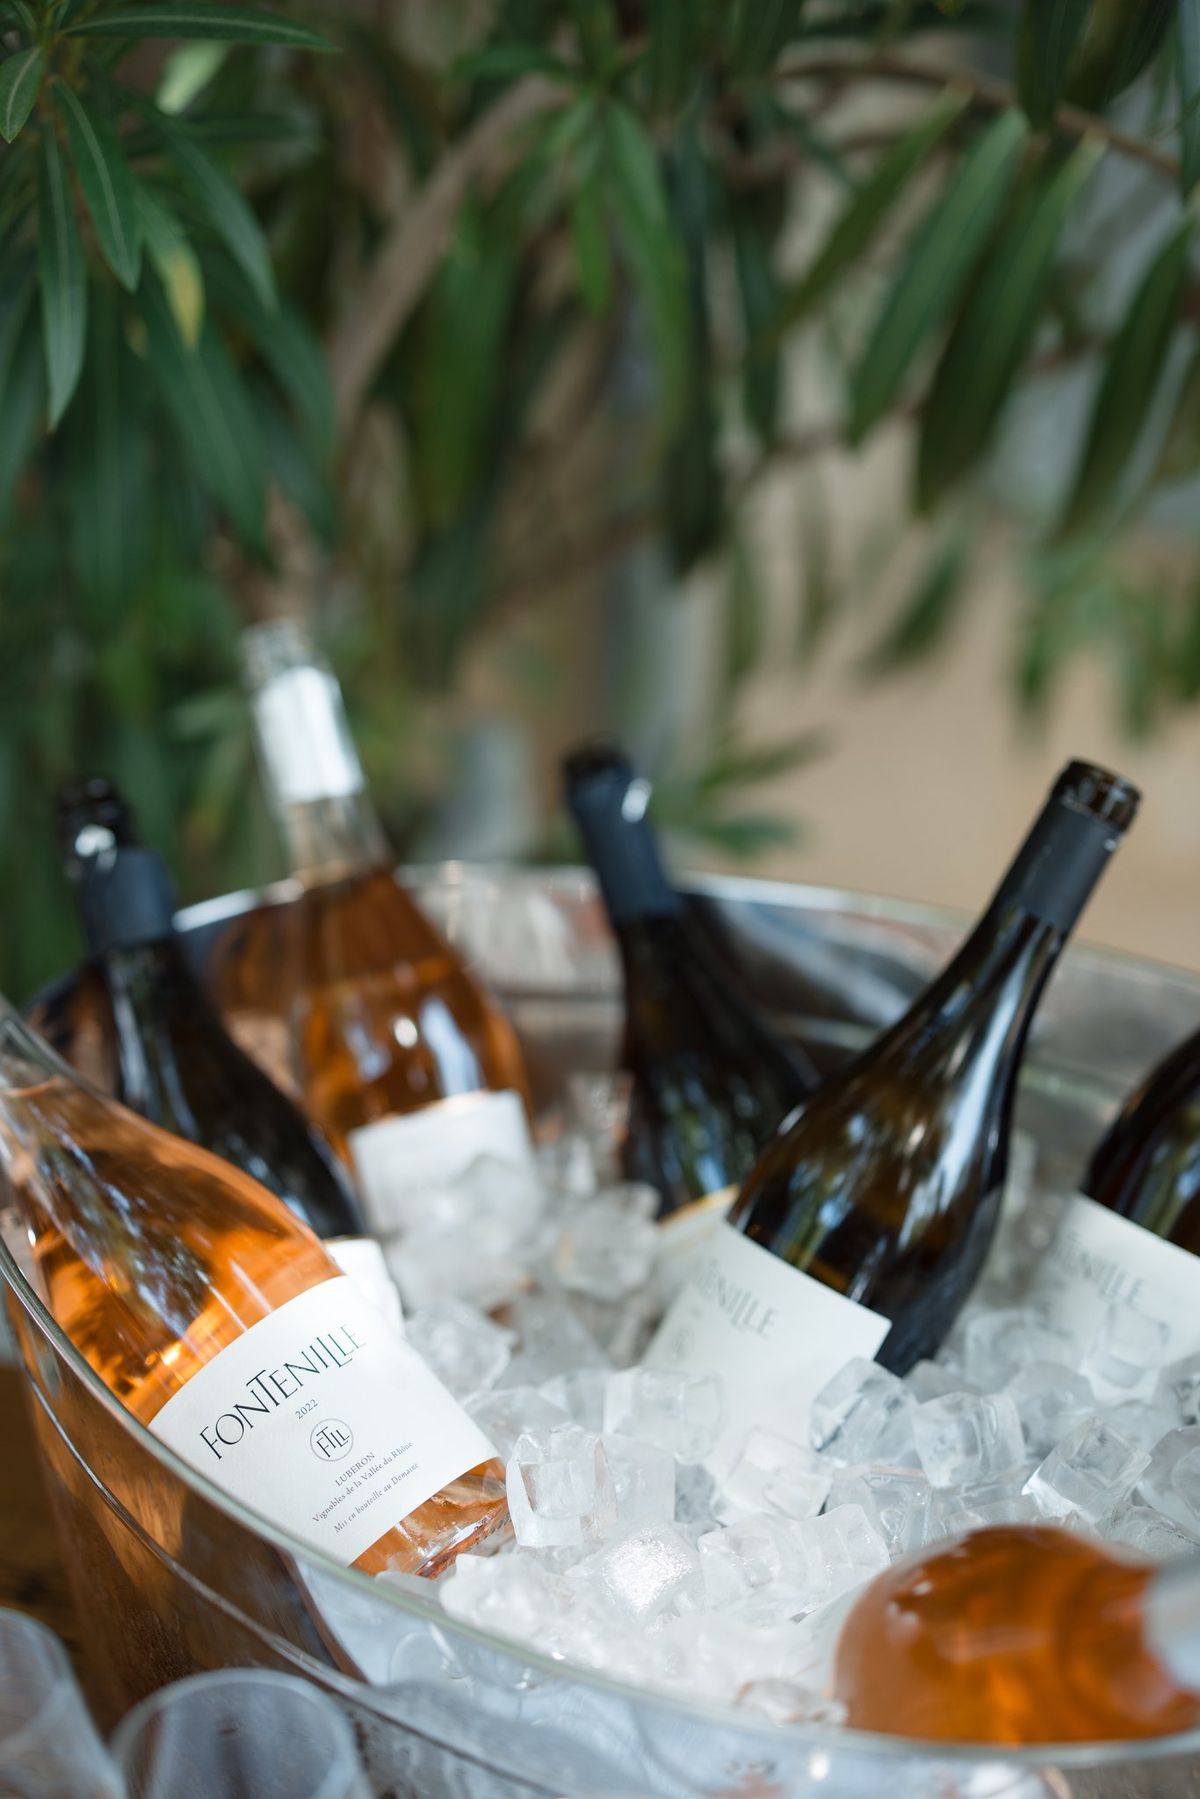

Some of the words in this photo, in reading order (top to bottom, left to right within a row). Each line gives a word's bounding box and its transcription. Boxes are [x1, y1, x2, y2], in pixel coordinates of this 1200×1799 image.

[200, 1323, 367, 1459] FONTENILLE
[294, 1399, 319, 1420] 2022
[312, 1494, 346, 1523] Vignobles
[346, 1486, 355, 1495] de
[353, 1479, 362, 1488] la
[361, 1463, 383, 1481] Vallée
[383, 1456, 393, 1466] du
[391, 1441, 413, 1459] Rhône
[333, 1520, 349, 1533] Mis
[348, 1513, 357, 1522] en
[355, 1489, 383, 1514] bouteille
[383, 1483, 392, 1493] au
[390, 1462, 419, 1486] Domaine
[334, 1451, 375, 1487] LUBERON
